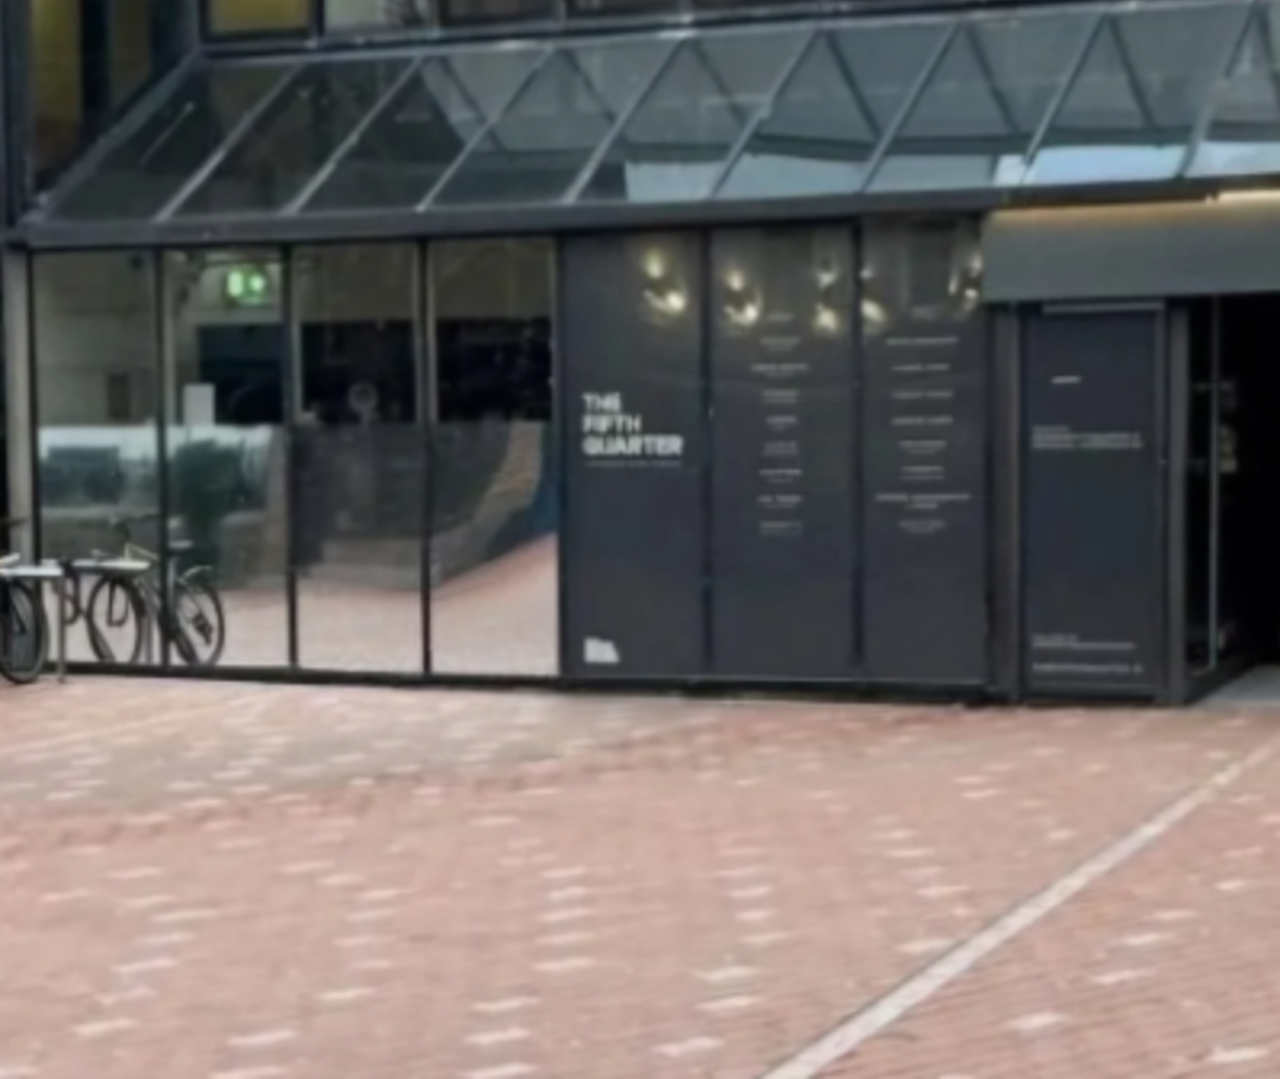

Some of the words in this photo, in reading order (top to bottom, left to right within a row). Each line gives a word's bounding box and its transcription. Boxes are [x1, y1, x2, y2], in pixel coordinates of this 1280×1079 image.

[582, 391, 622, 413] THE
[581, 413, 642, 434] FIFTH
[581, 434, 684, 457] QUARTER
